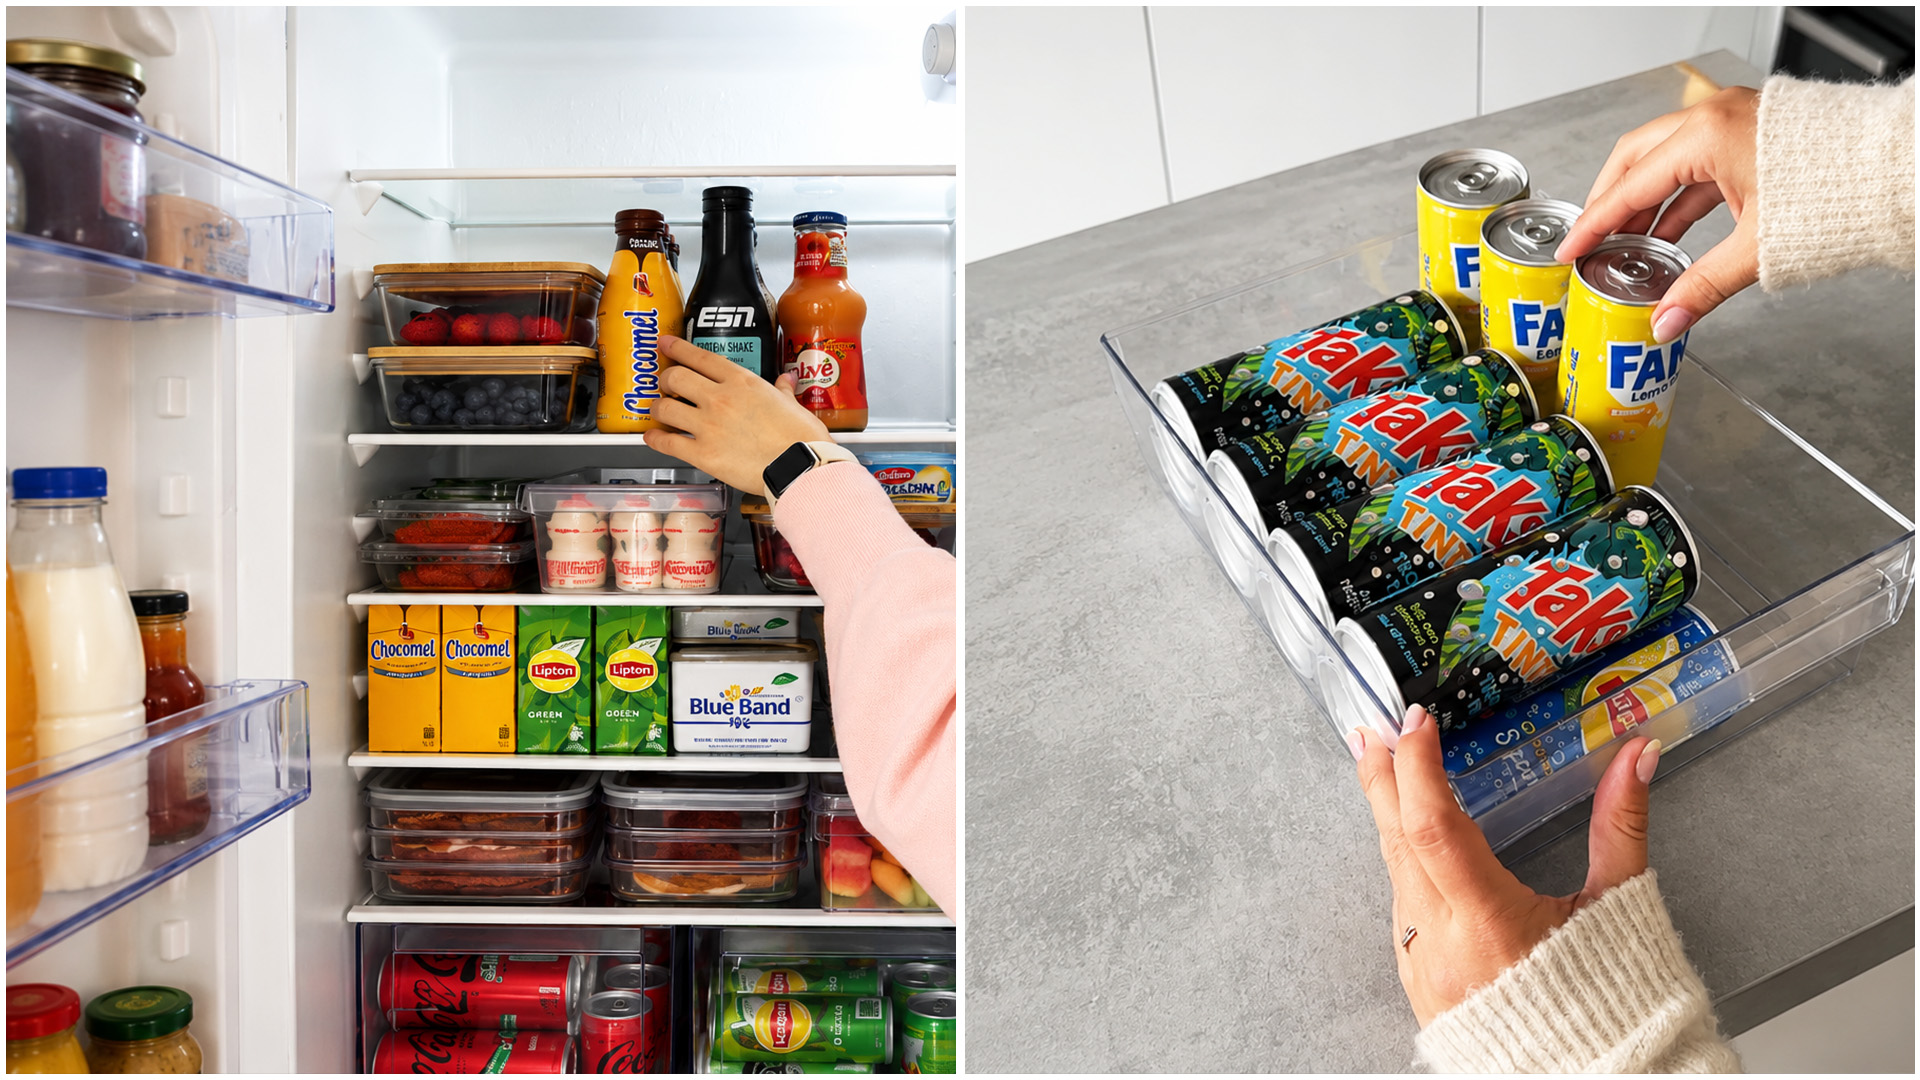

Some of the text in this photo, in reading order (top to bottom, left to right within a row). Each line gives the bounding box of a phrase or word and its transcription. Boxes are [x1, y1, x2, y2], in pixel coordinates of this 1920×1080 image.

[727, 341, 754, 353] SHAKE
[622, 307, 662, 416] Chocomel
[370, 638, 437, 660] Chocomel
[445, 638, 511, 660] Chocomel
[534, 662, 574, 679] Lipton
[612, 664, 651, 679] Lipton
[689, 697, 791, 716] Blue Band
